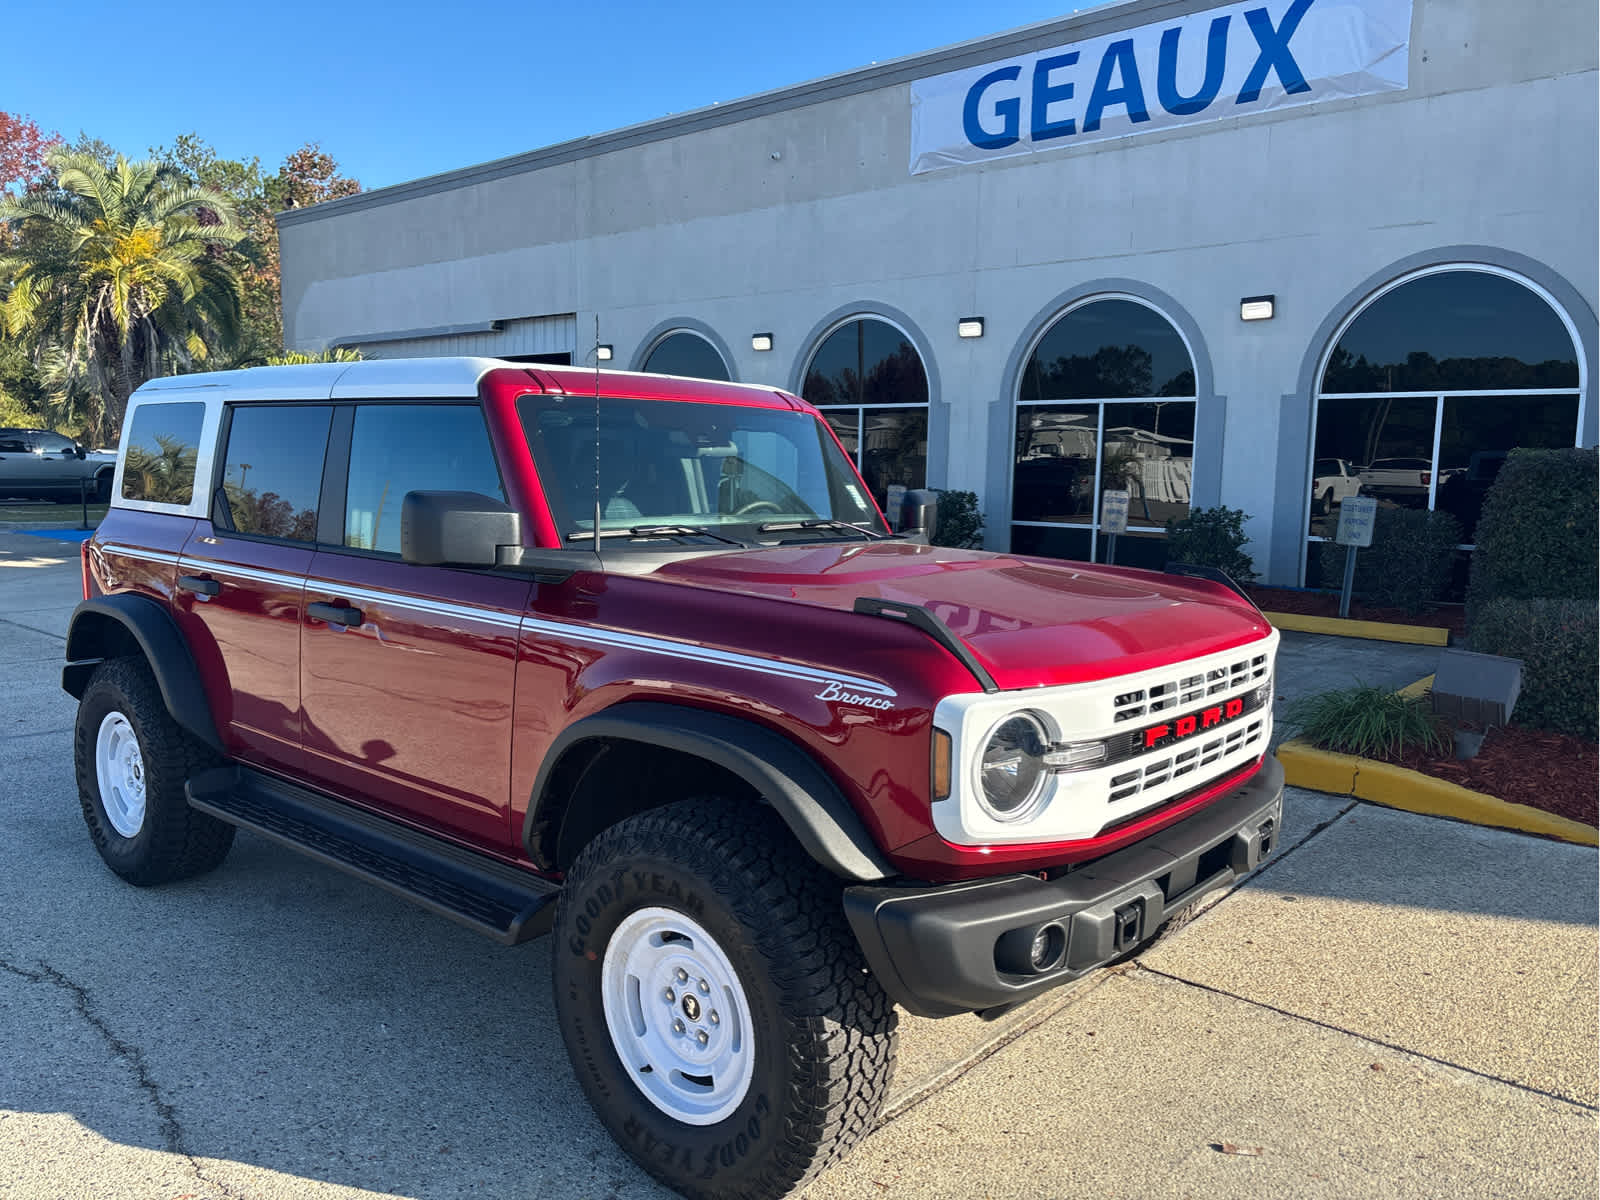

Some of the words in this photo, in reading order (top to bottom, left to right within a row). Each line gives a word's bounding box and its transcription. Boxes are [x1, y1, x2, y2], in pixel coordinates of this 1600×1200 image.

[963, 0, 1313, 150] GEAUX
[814, 680, 895, 710] Bronco
[1144, 698, 1243, 747] FORD
